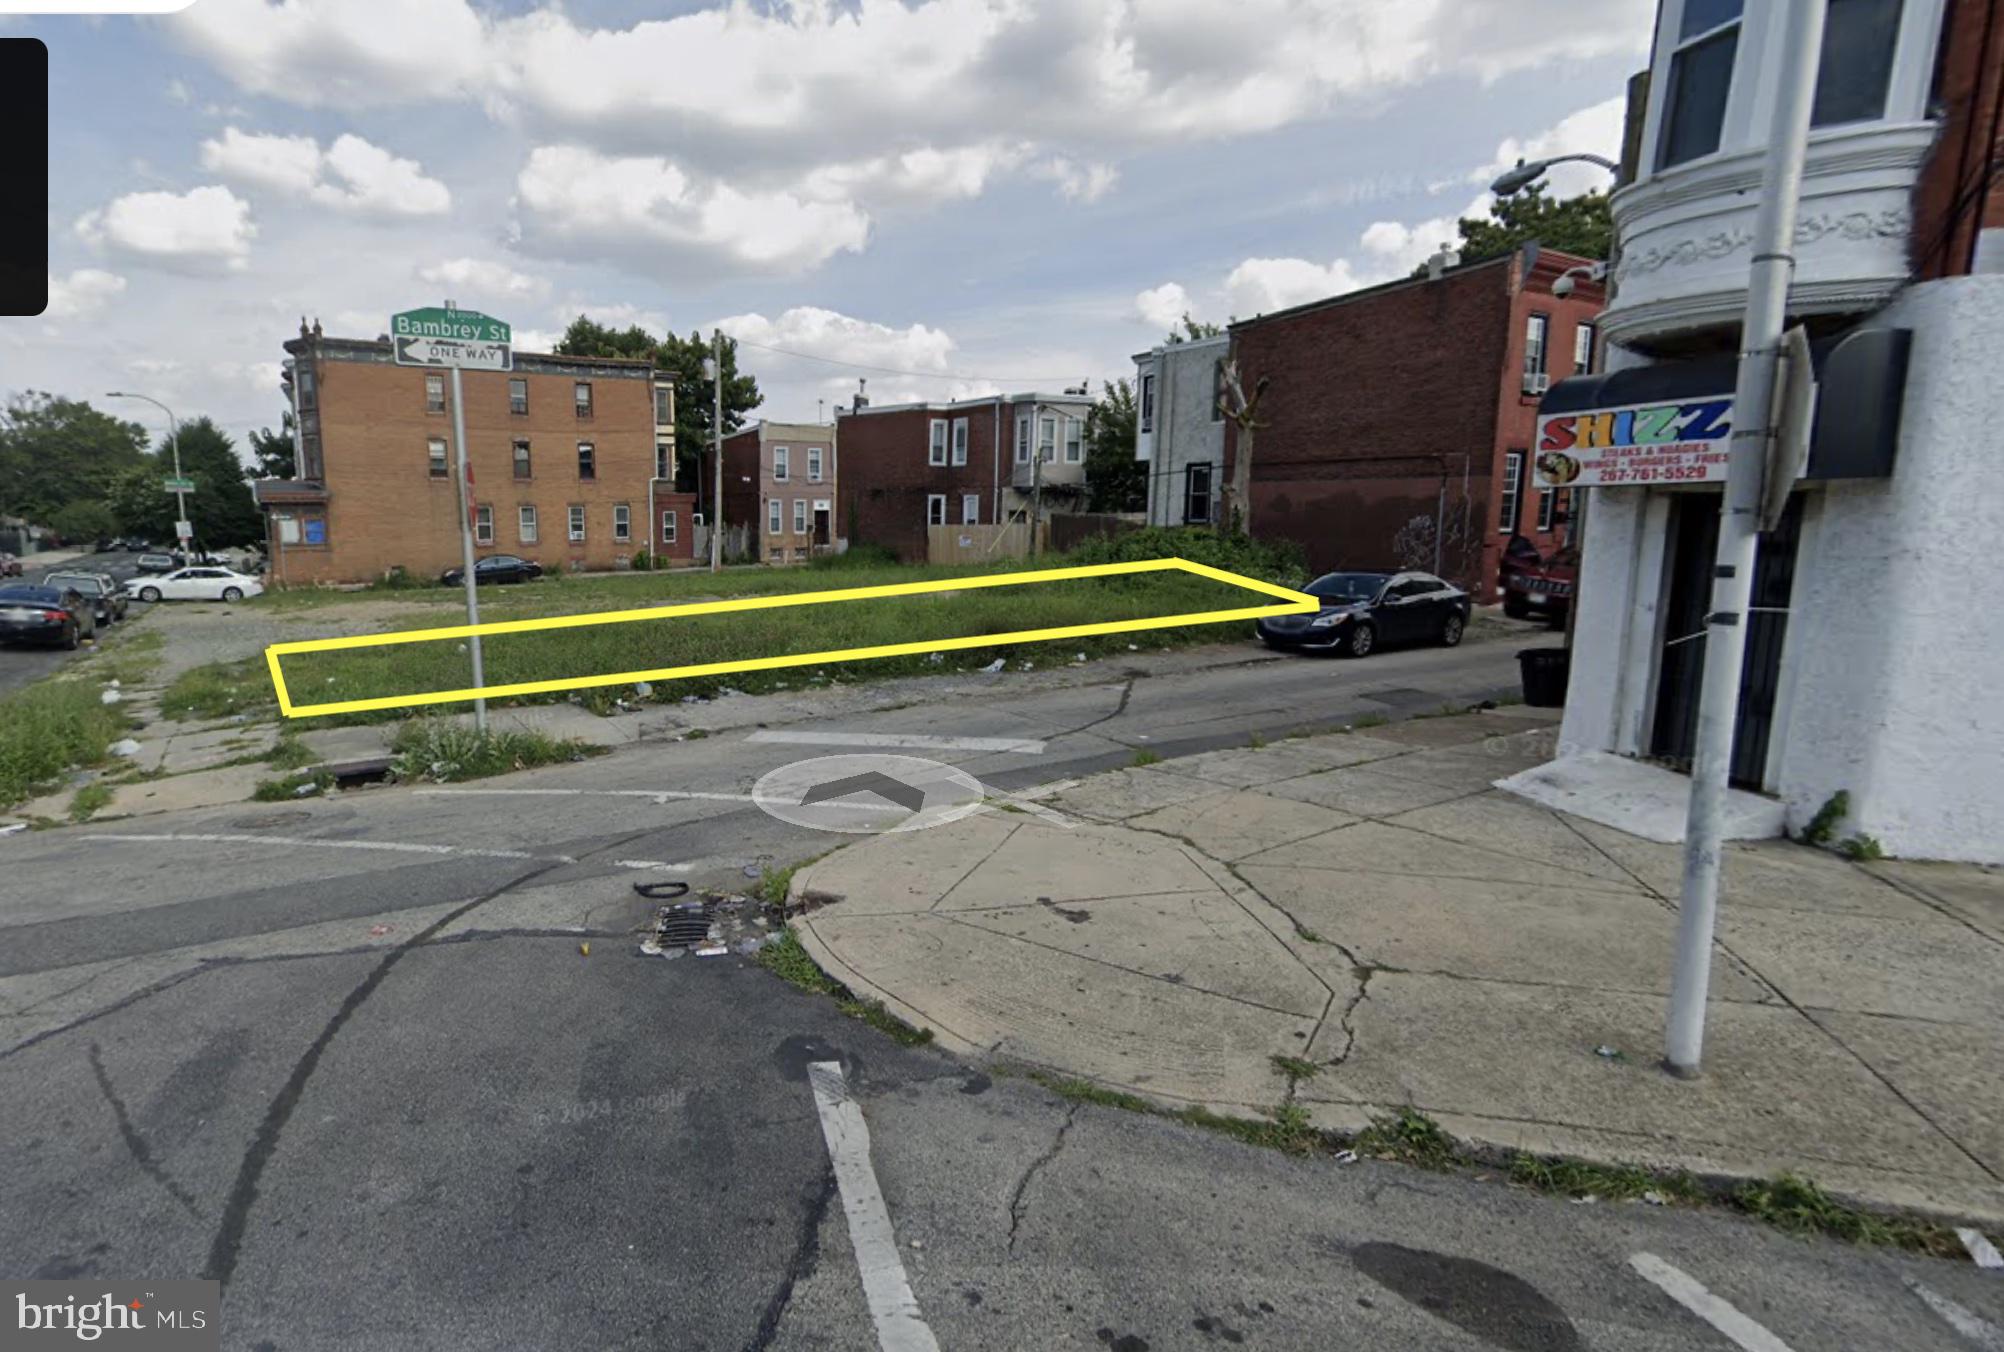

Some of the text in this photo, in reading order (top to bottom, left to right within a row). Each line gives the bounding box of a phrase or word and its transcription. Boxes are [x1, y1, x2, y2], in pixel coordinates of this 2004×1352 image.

[397, 317, 507, 340] Bambrey St
[430, 346, 496, 360] ONE WAY
[1540, 400, 1732, 451] SHIZZ
